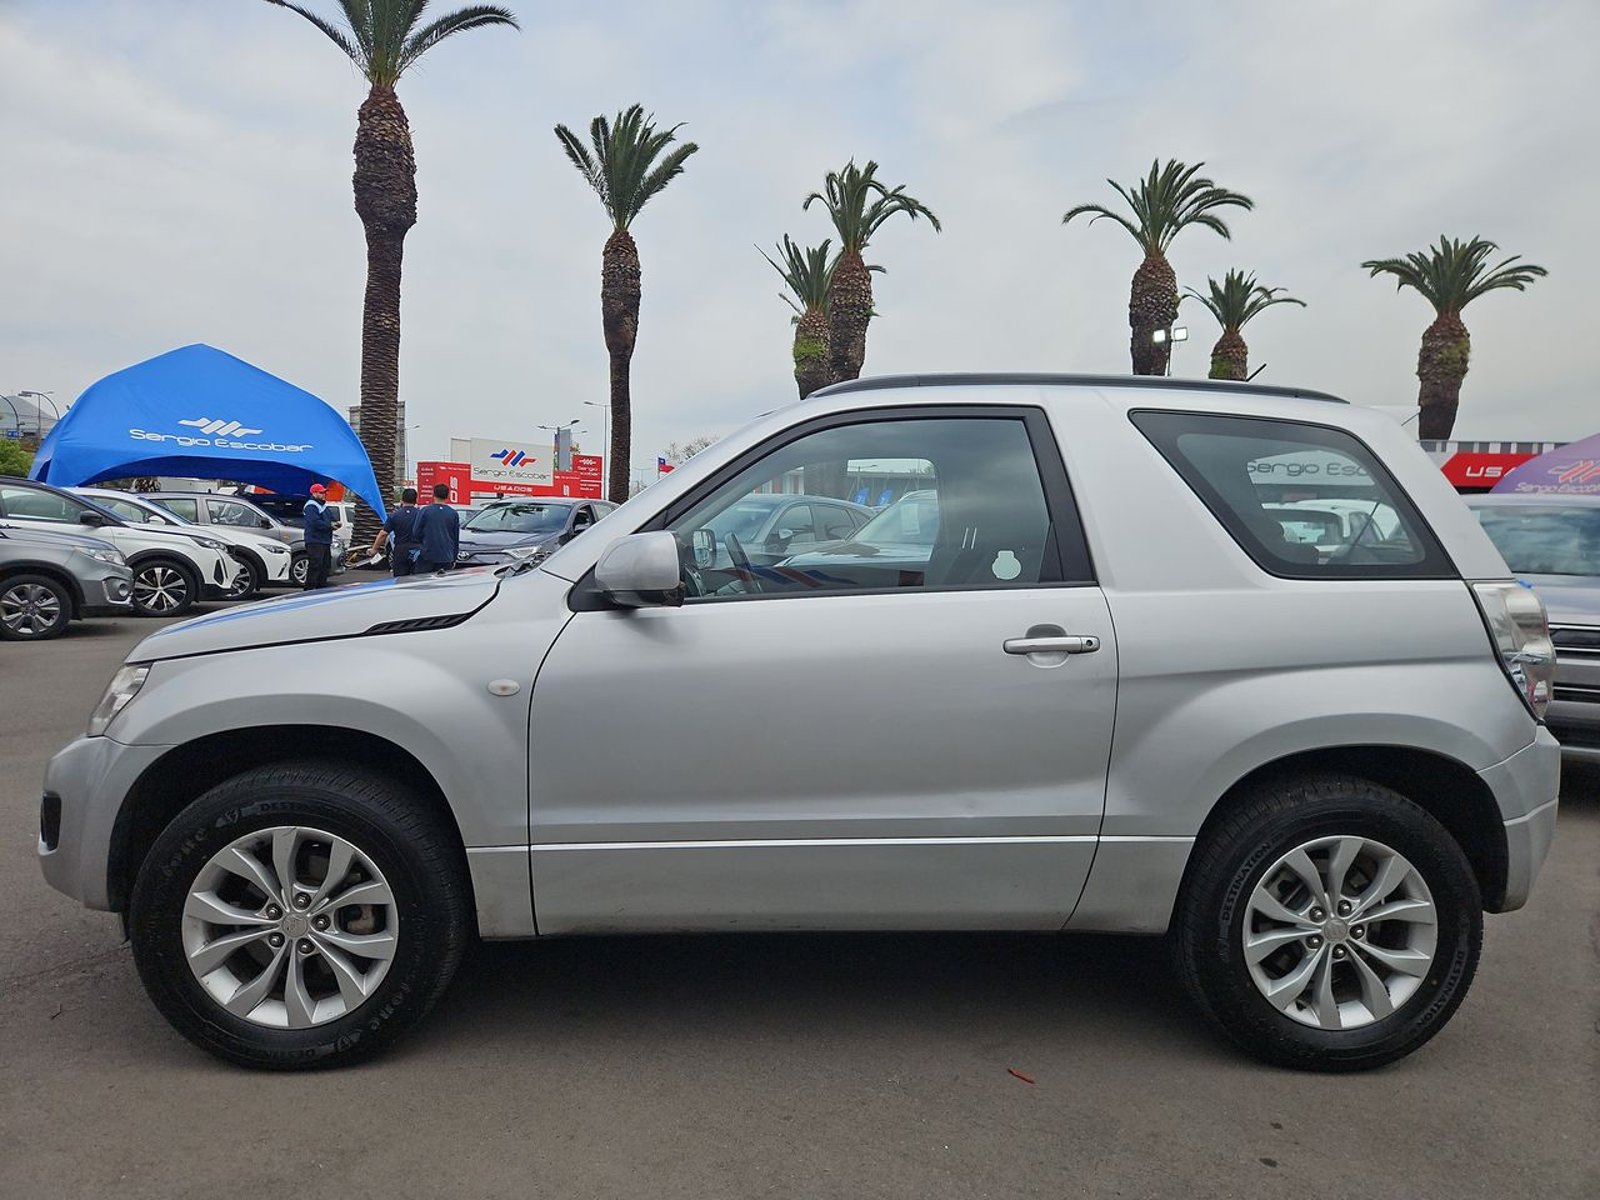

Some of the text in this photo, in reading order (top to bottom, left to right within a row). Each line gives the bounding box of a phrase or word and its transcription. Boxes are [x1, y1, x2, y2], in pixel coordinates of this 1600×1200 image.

[129, 428, 314, 453] Sergio Escobar
[1246, 460, 1320, 477] Sergio
[493, 484, 534, 493] USADOS
[1221, 841, 1272, 922] DESTINATION
